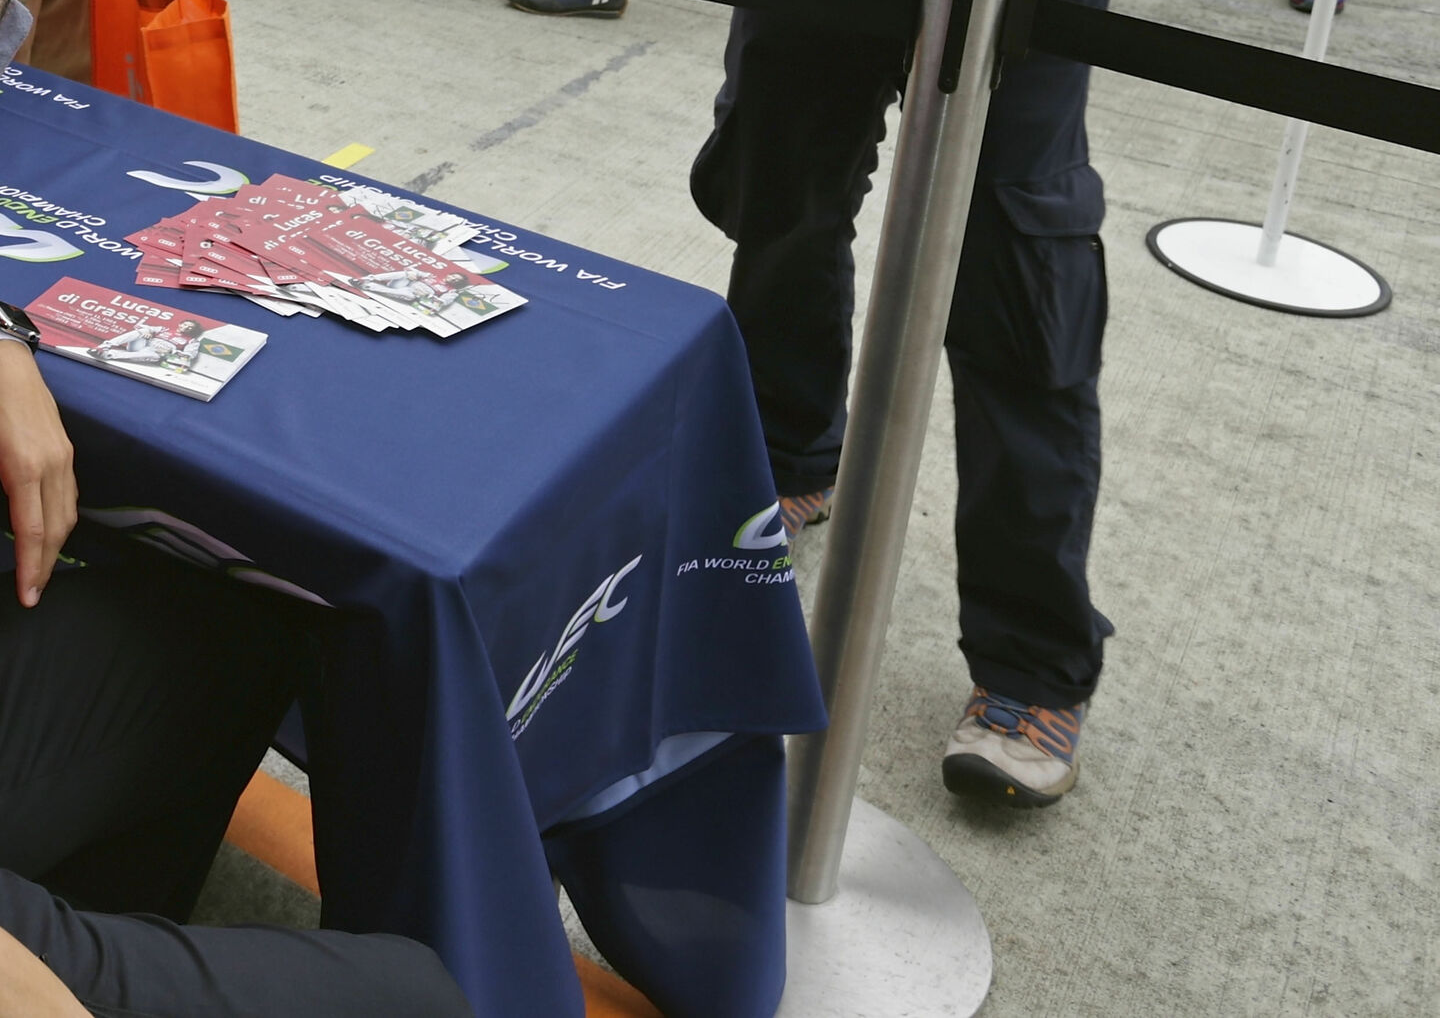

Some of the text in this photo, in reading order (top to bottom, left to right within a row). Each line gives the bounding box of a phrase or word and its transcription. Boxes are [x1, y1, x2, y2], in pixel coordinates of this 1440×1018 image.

[53, 92, 91, 111] FIA
[273, 209, 324, 233] Lucas
[55, 219, 145, 261] WORLD
[345, 229, 363, 241] di
[363, 238, 421, 269] Grassi
[392, 240, 449, 271] Lucas
[576, 269, 627, 291] FIA
[58, 293, 80, 305] di
[80, 299, 150, 327] Grassi
[109, 294, 175, 322] Lucas
[676, 559, 699, 577] FIA
[704, 557, 770, 571] WORLD
